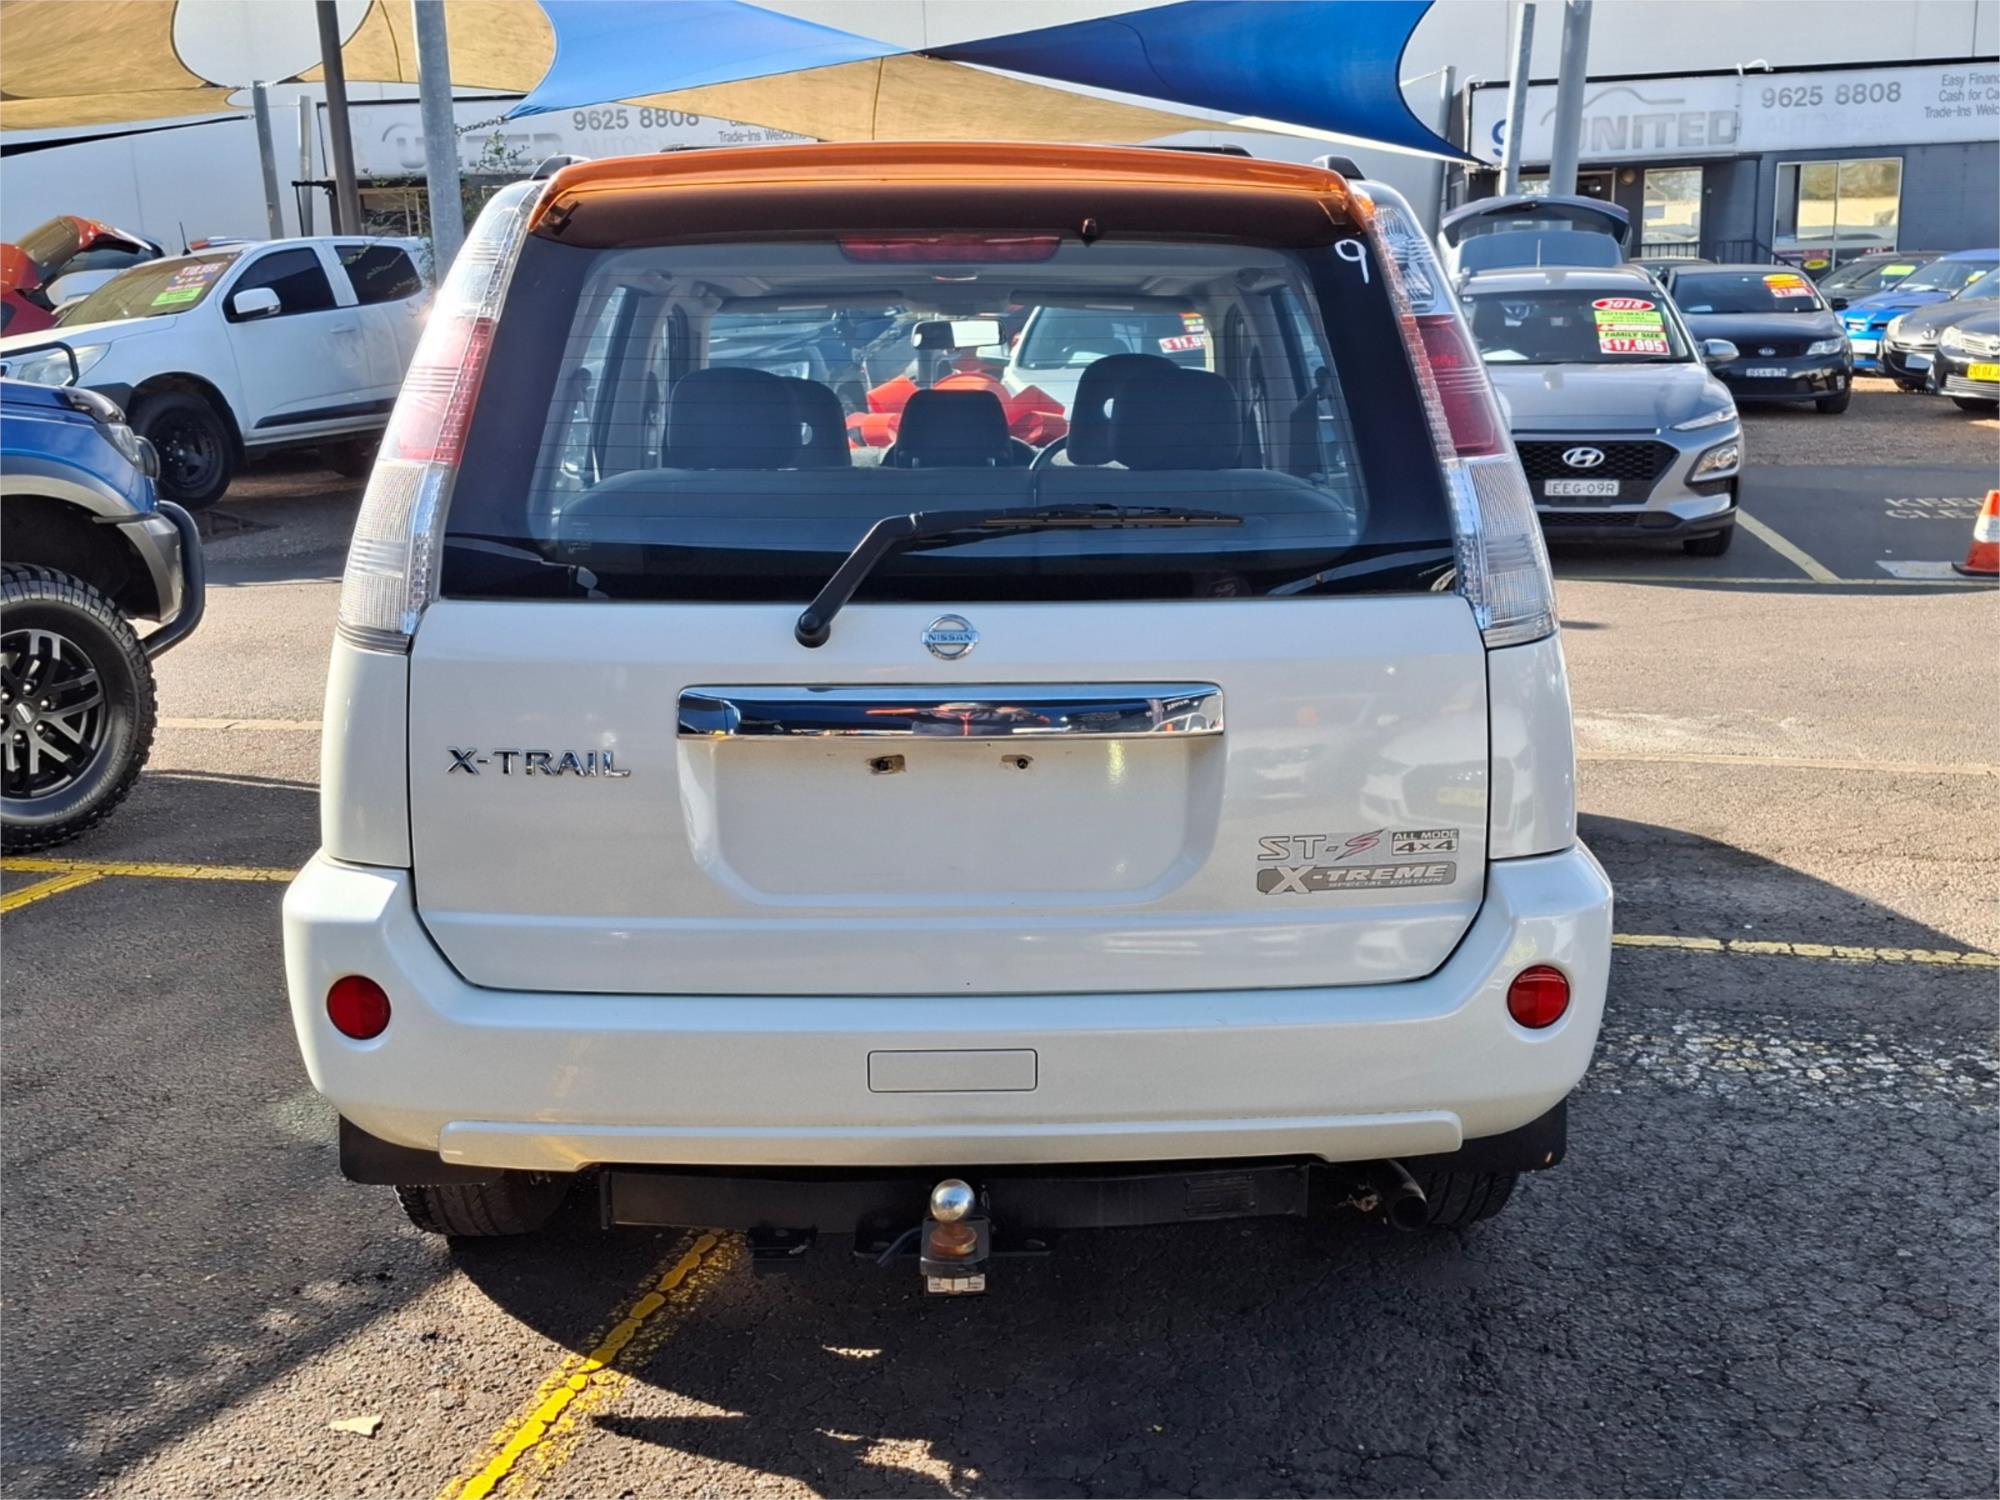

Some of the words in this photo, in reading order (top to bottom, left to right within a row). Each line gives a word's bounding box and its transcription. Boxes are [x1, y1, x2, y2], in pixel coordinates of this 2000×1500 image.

[1941, 73, 1966, 89] Easy
[1761, 87, 1823, 108] 9625
[1834, 81, 1902, 105] 8808
[1938, 89, 1965, 103] Cash
[1968, 88, 1982, 101] for
[1924, 105, 1972, 119] Trade-Ins
[572, 109, 630, 132] 9625
[717, 129, 762, 143] Trade-Ins
[1334, 238, 1370, 285] 9
[928, 633, 973, 641] NISSAN
[446, 747, 632, 777] X-TRAIL
[1420, 830, 1457, 839] MODE
[1266, 864, 1449, 895] X-TREME
[1328, 880, 1382, 888] SPECIAL
[1390, 876, 1443, 885] EDITION
